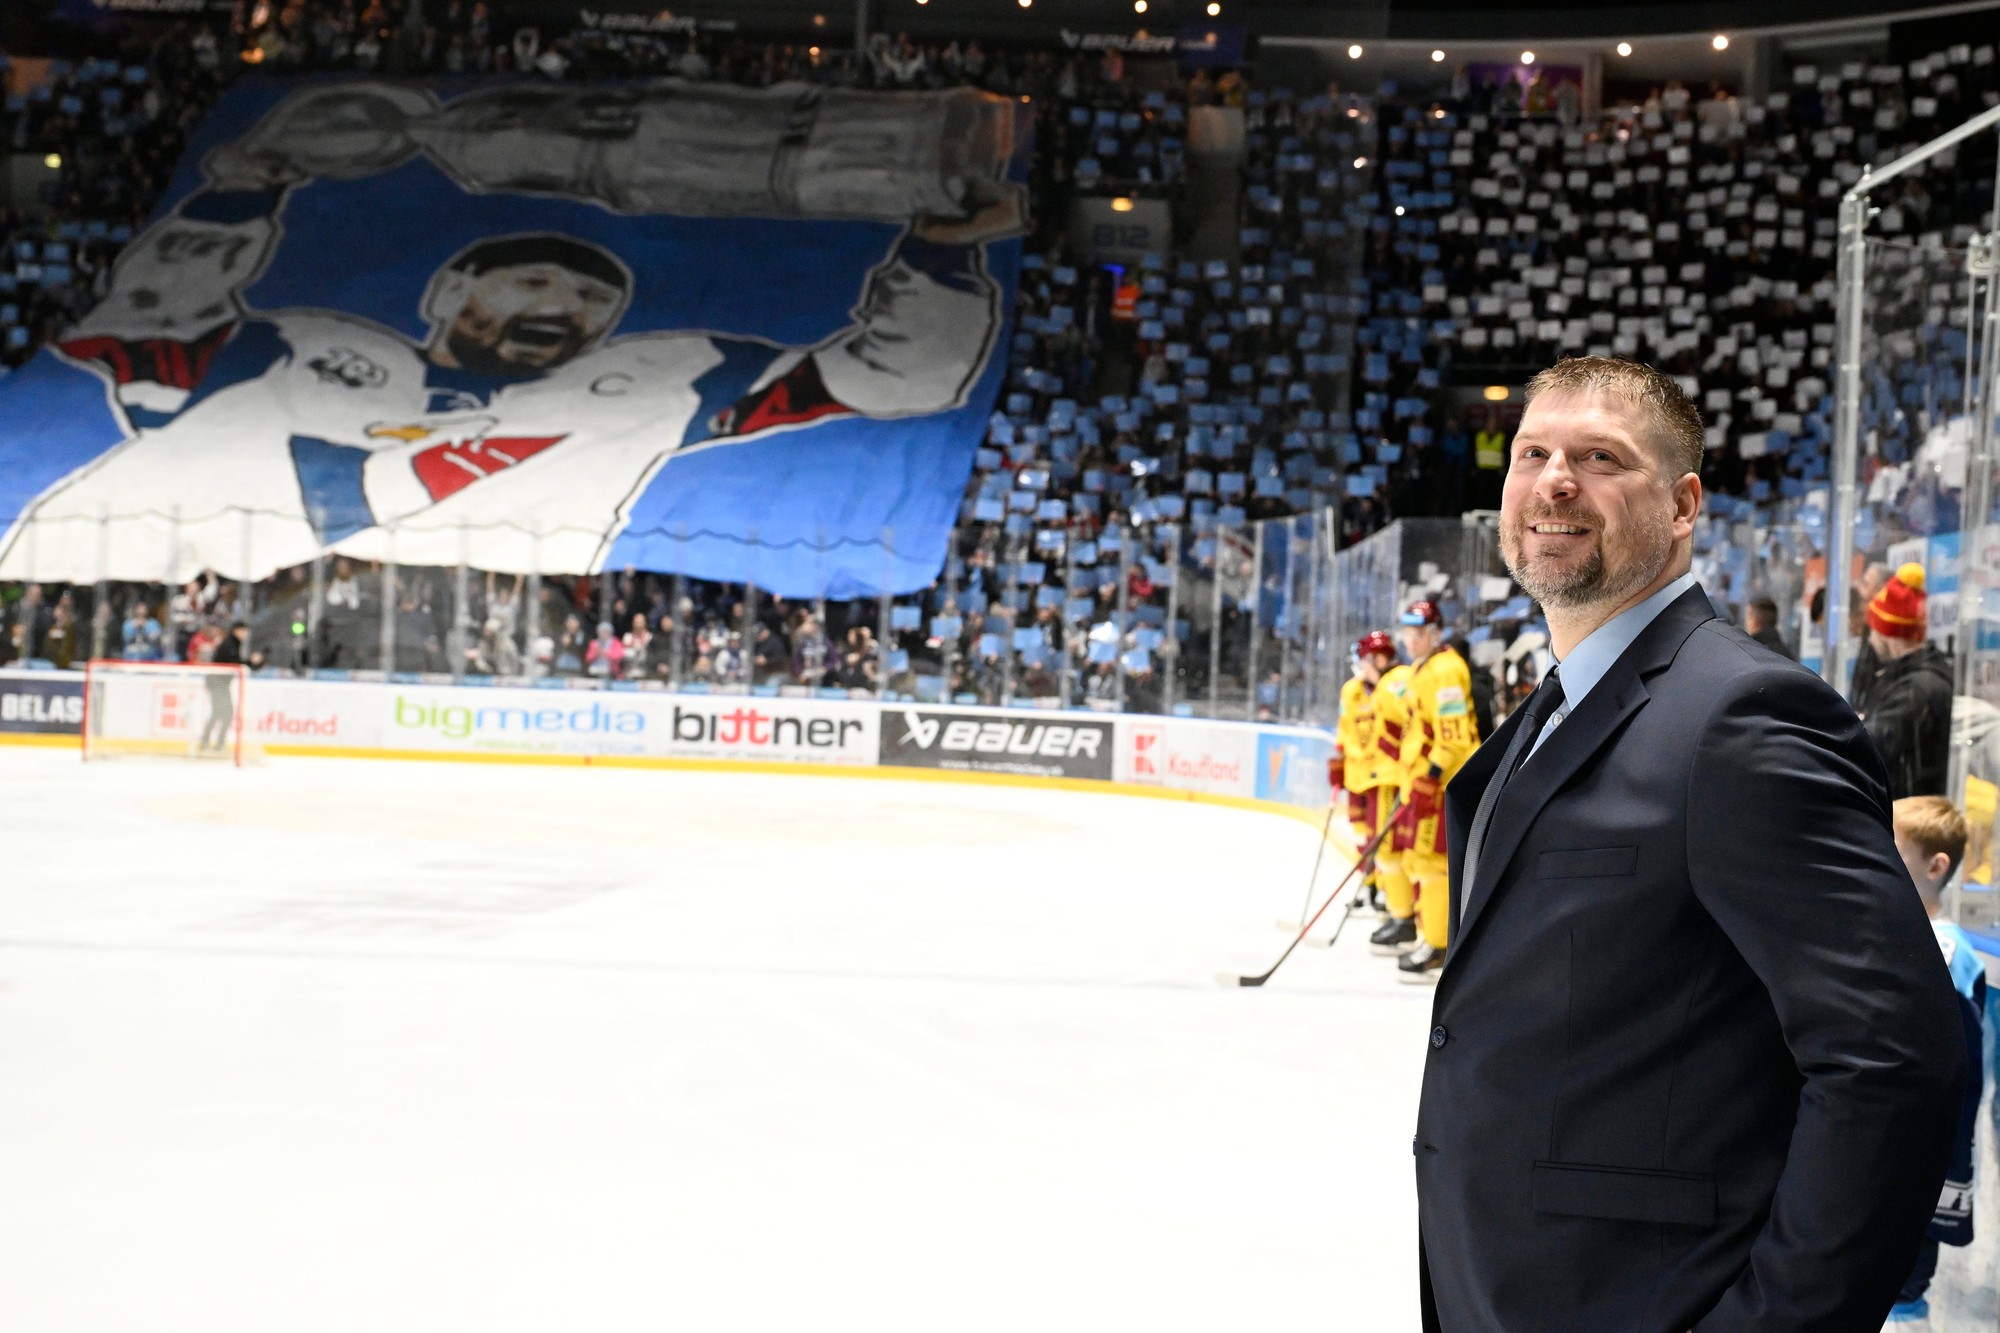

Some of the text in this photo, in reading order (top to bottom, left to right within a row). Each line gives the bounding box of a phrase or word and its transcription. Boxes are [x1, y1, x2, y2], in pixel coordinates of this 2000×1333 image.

[395, 696, 646, 739] bigmedia
[673, 706, 863, 748] bittner
[1168, 752, 1241, 782] Kaufland
